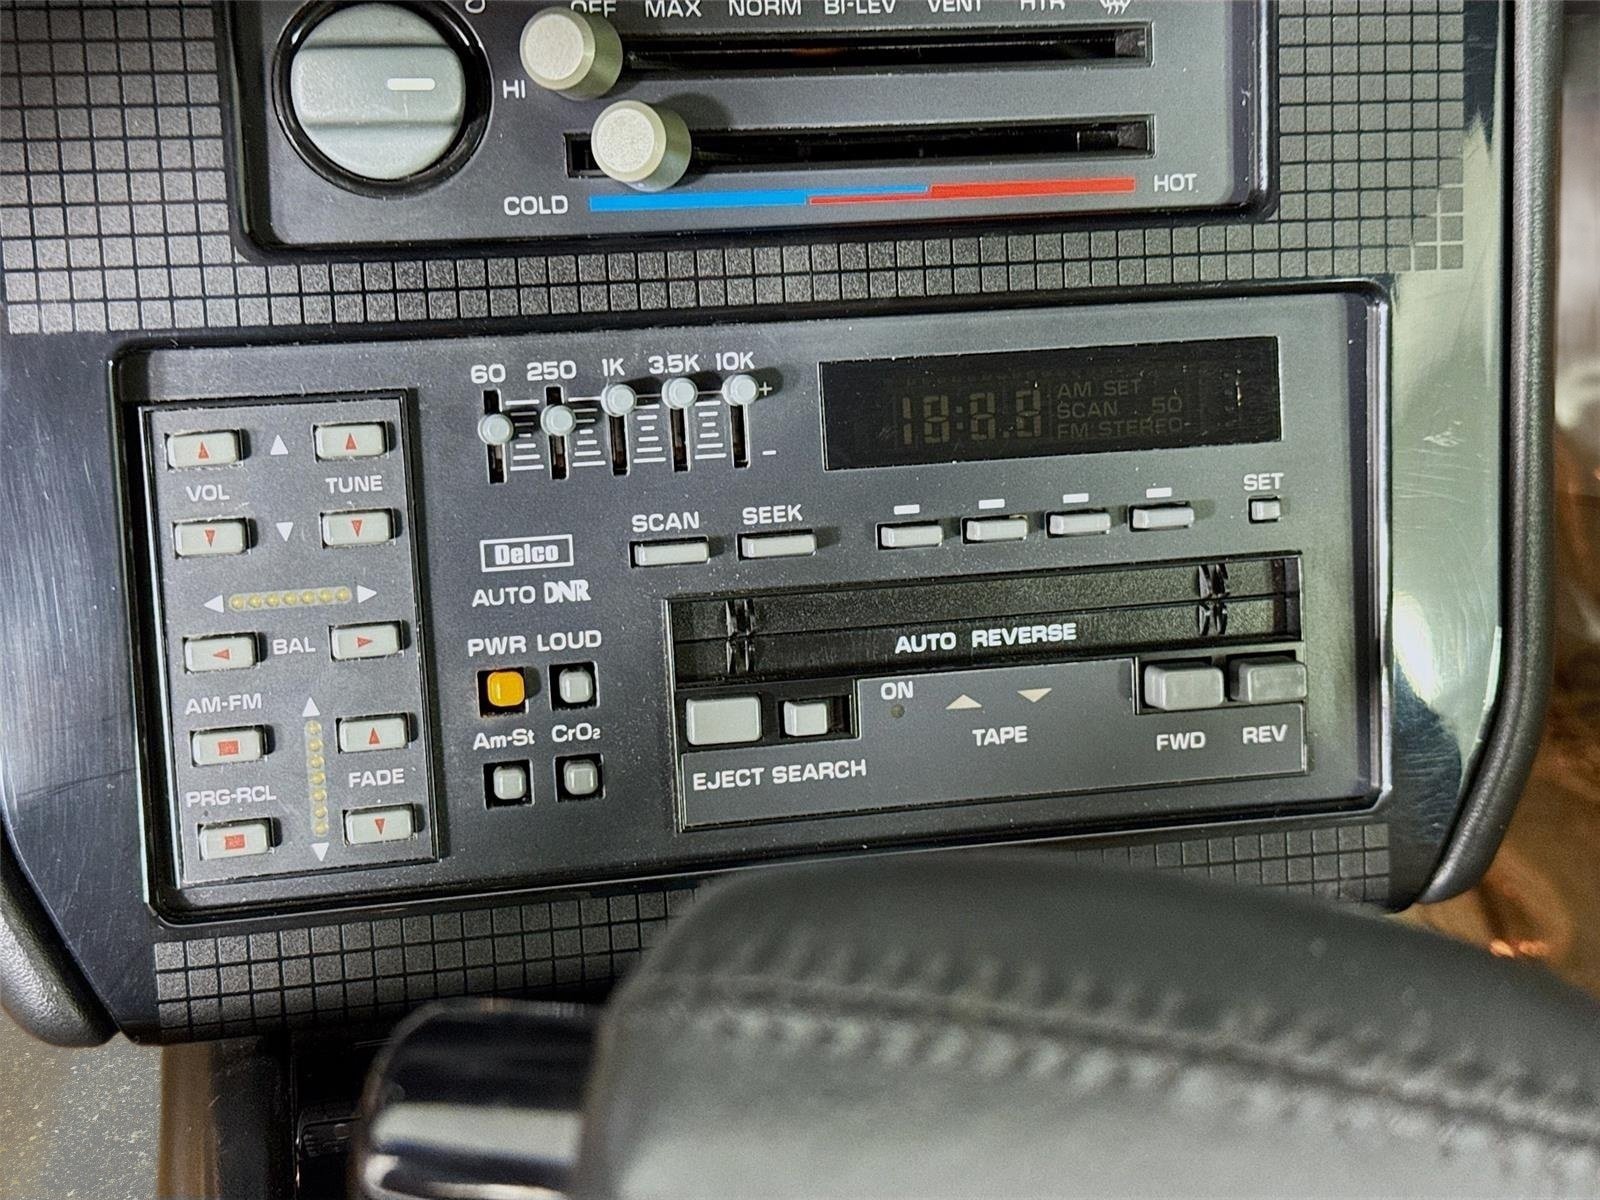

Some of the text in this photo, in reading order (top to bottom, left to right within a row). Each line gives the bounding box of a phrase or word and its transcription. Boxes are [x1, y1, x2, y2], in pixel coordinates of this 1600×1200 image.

[570, 0, 617, 18] OFF
[646, 0, 701, 17] MAX
[729, 0, 801, 16] NORM
[825, 0, 895, 14] BI-LEV
[928, 0, 980, 12] VENT
[503, 80, 525, 98] HI
[1153, 173, 1197, 192] HOT
[504, 195, 568, 215] COLD
[471, 352, 754, 383] 60 250 1K 3.5K 10K
[1056, 378, 1141, 399] AM SET
[1056, 401, 1119, 419] SCAN
[1057, 416, 1183, 440] FM STEREO
[325, 475, 382, 493] TUNE
[1244, 473, 1284, 490] SET
[186, 485, 229, 501] VOL
[632, 504, 802, 532] SCAN SEEK
[494, 543, 559, 565] Delco
[472, 580, 591, 607] AUTO DNR
[273, 637, 315, 654] BAL
[468, 630, 601, 656] PWR LOUD
[895, 623, 1076, 653] AUTO REVERSE
[881, 681, 913, 699] ON
[185, 693, 261, 715] AM-FM
[473, 729, 534, 750] Am-St
[972, 726, 1027, 746] TAPE
[1157, 725, 1287, 750] FWD REV
[349, 768, 404, 787] FADE
[693, 759, 866, 790] EJECT SEARCH
[186, 785, 276, 807] PRG-RCL
